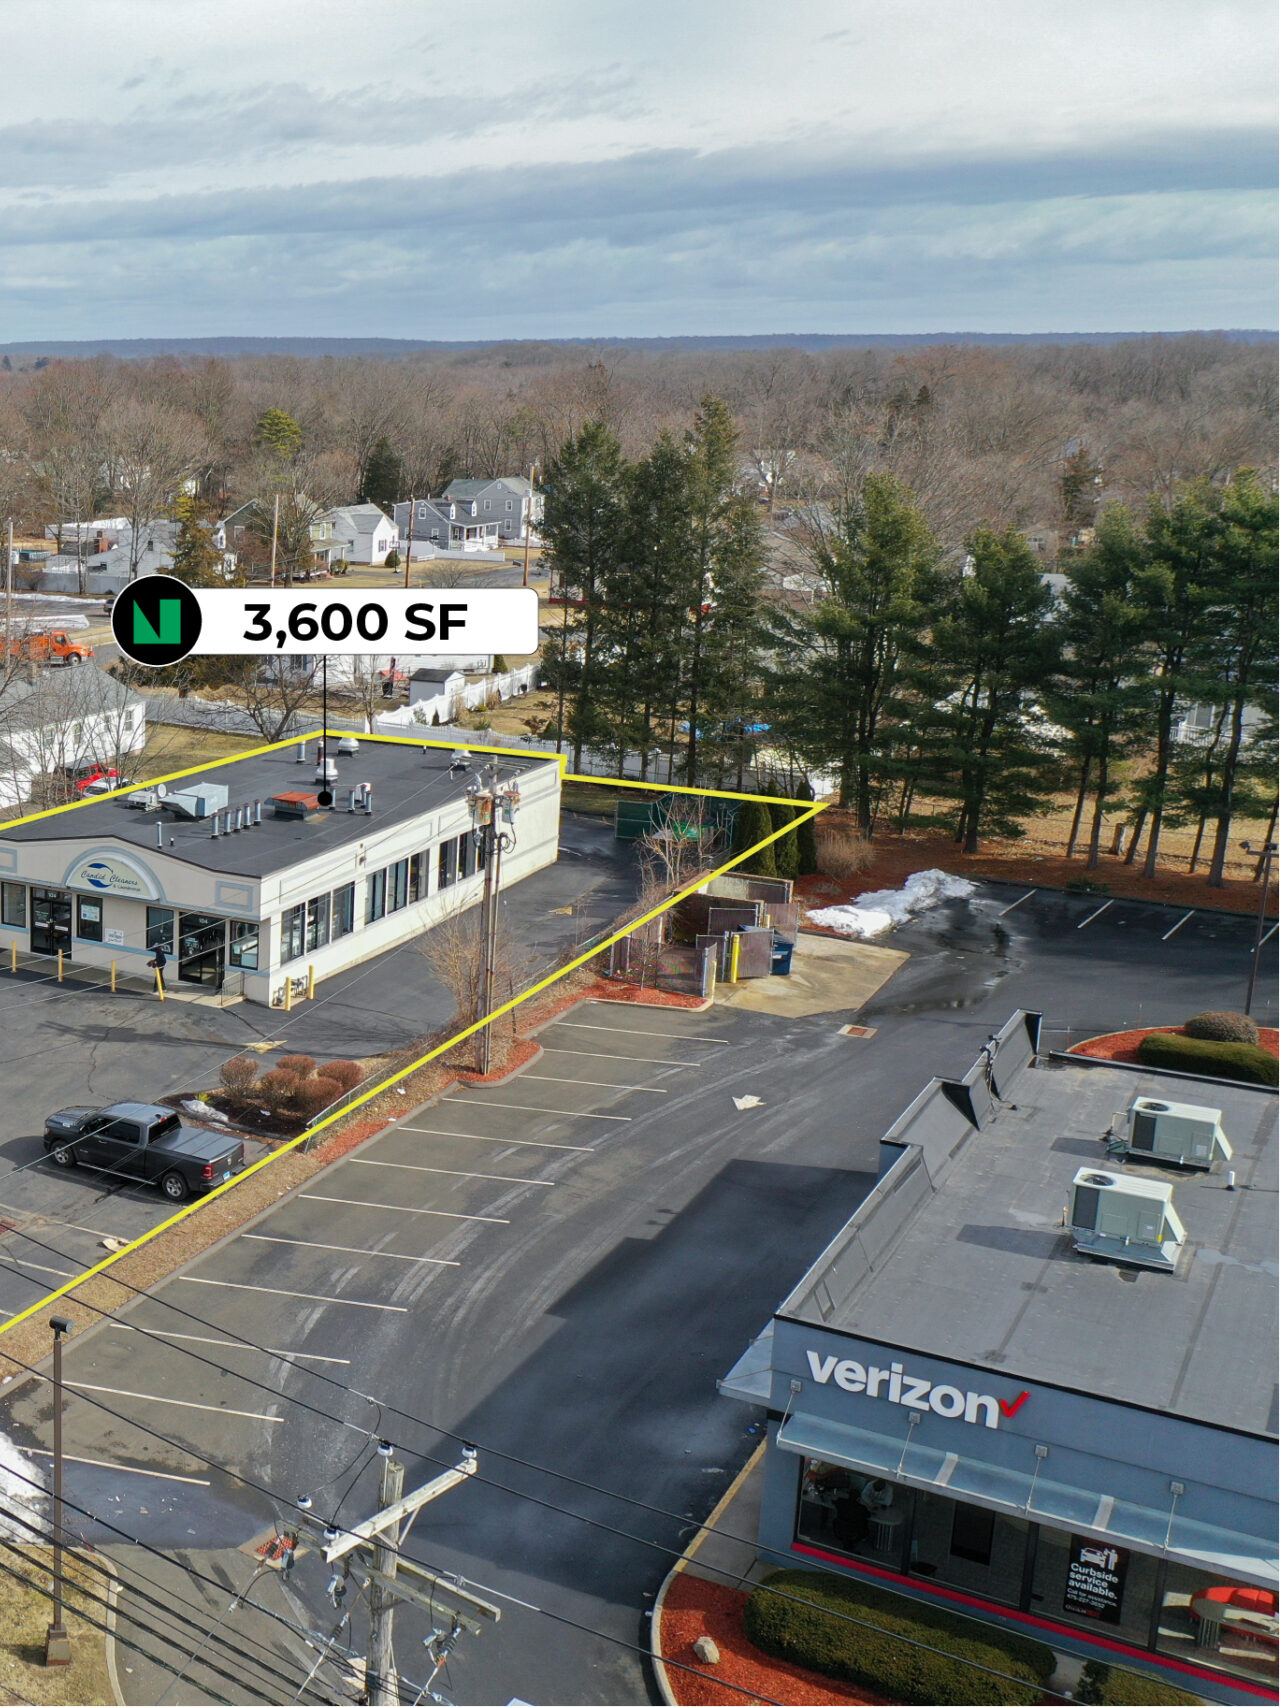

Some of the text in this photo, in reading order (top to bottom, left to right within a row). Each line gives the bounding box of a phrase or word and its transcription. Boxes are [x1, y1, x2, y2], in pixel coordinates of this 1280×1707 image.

[80, 870, 138, 886] Candid Cleaners
[806, 1350, 1000, 1429] verizon
[1069, 1571, 1108, 1588] service
[1070, 1562, 1119, 1584] Curbside
[1066, 1587, 1078, 1595] Call
[1068, 1580, 1118, 1600] available.
